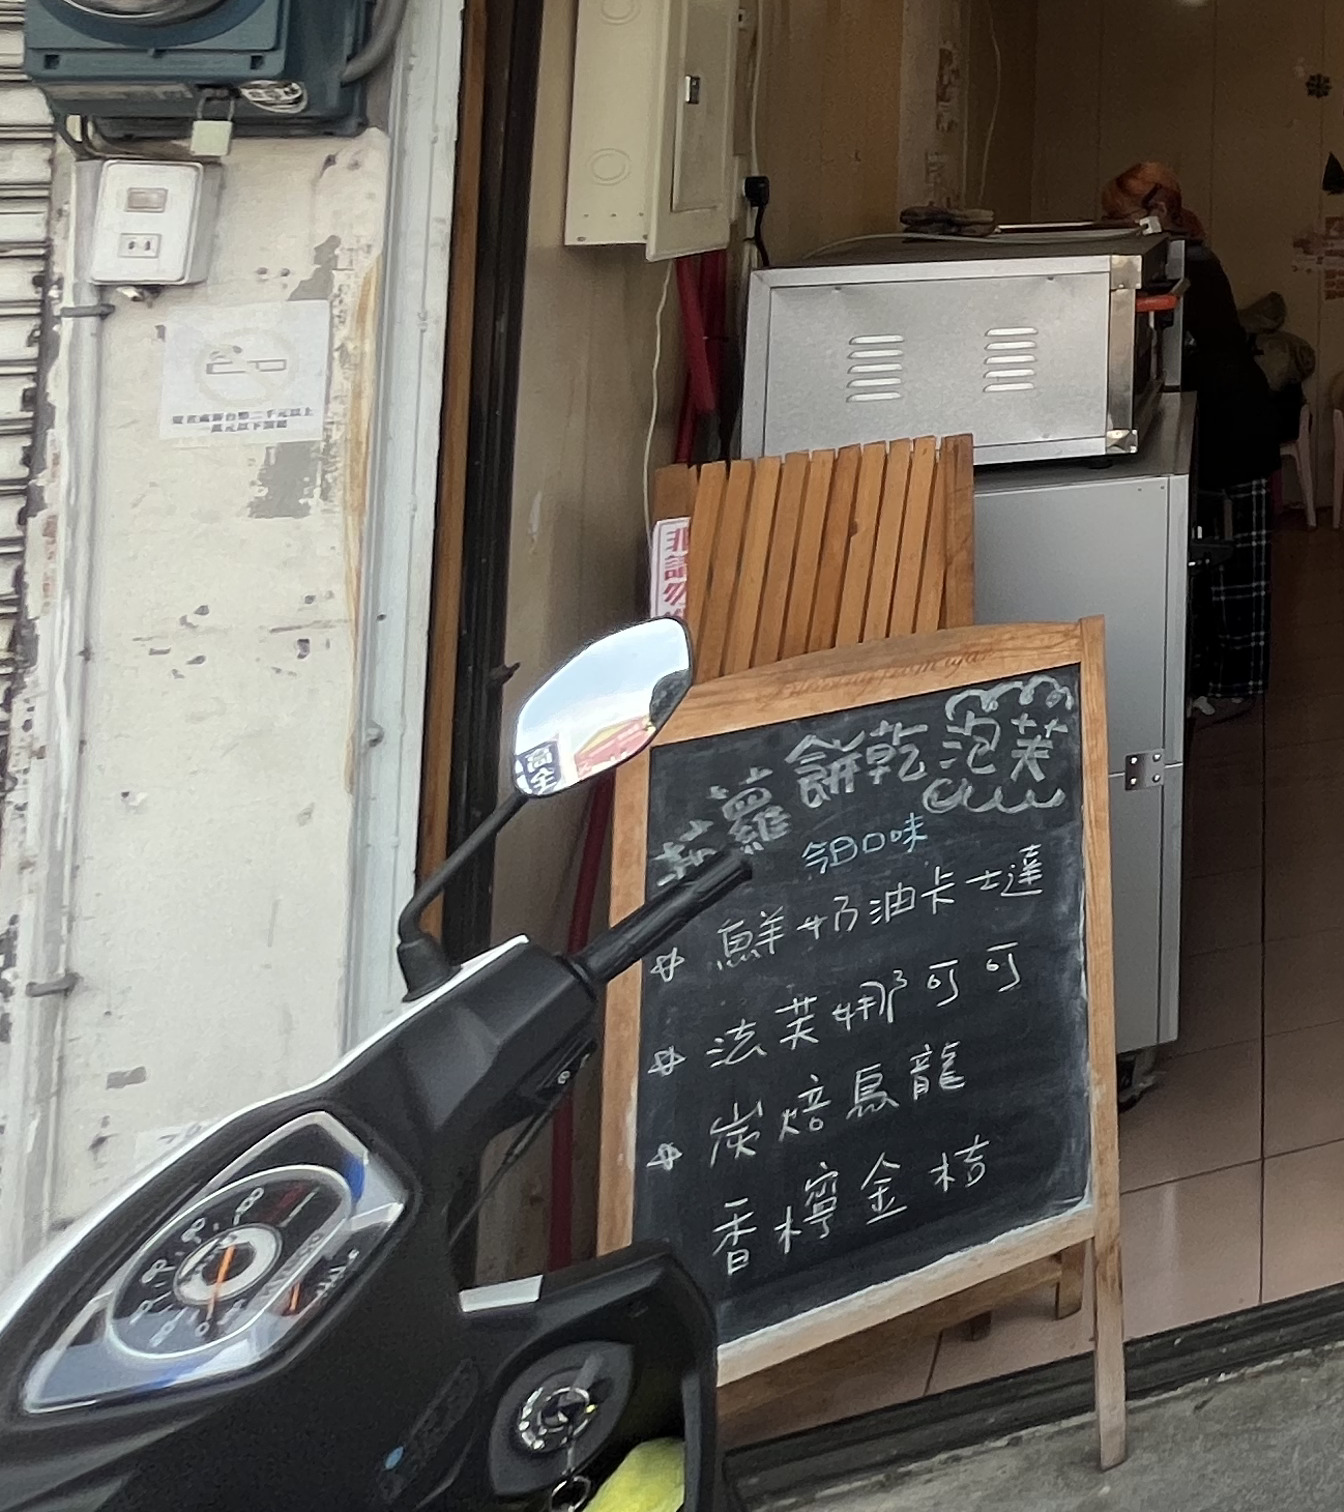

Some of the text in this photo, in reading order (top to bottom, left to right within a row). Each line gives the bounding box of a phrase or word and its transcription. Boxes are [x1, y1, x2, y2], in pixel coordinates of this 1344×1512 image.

[801, 812, 929, 875] 今日口味
[715, 844, 1044, 970] 鮮奶油卡士達
[712, 1134, 991, 1277] 香檸金桔
